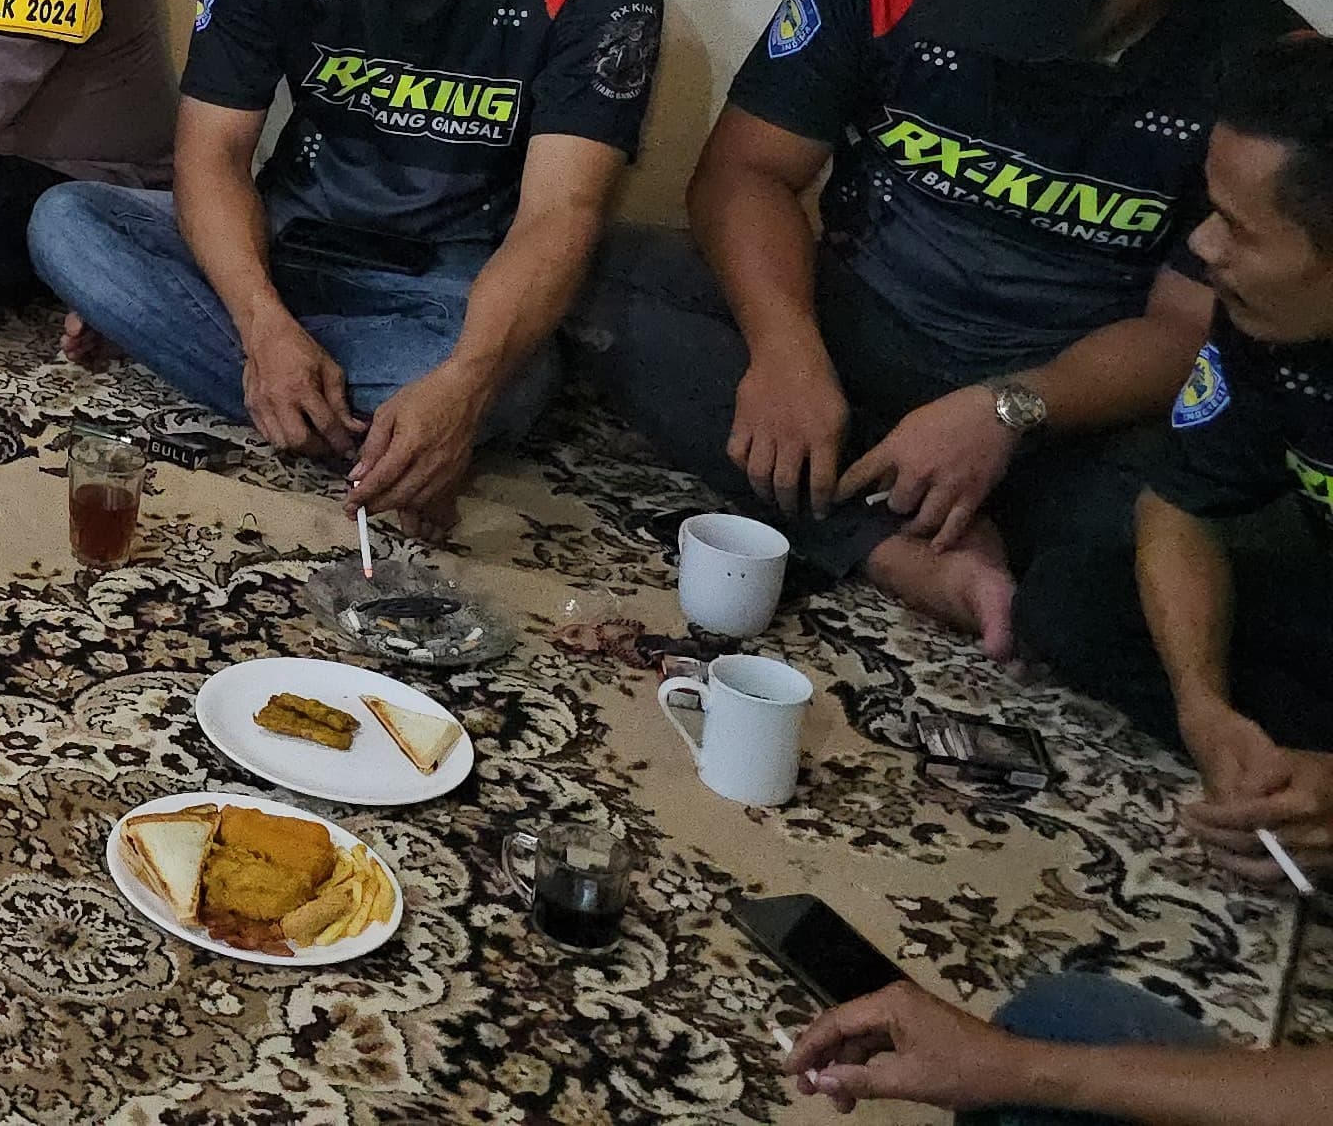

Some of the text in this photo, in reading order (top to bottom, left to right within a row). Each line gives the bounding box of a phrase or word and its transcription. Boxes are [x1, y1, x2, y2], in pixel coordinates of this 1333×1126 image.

[632, 3, 658, 18] KIN
[316, 56, 517, 122] RX-KING
[431, 116, 503, 139] GANSAL
[878, 120, 1169, 232] RX-KING
